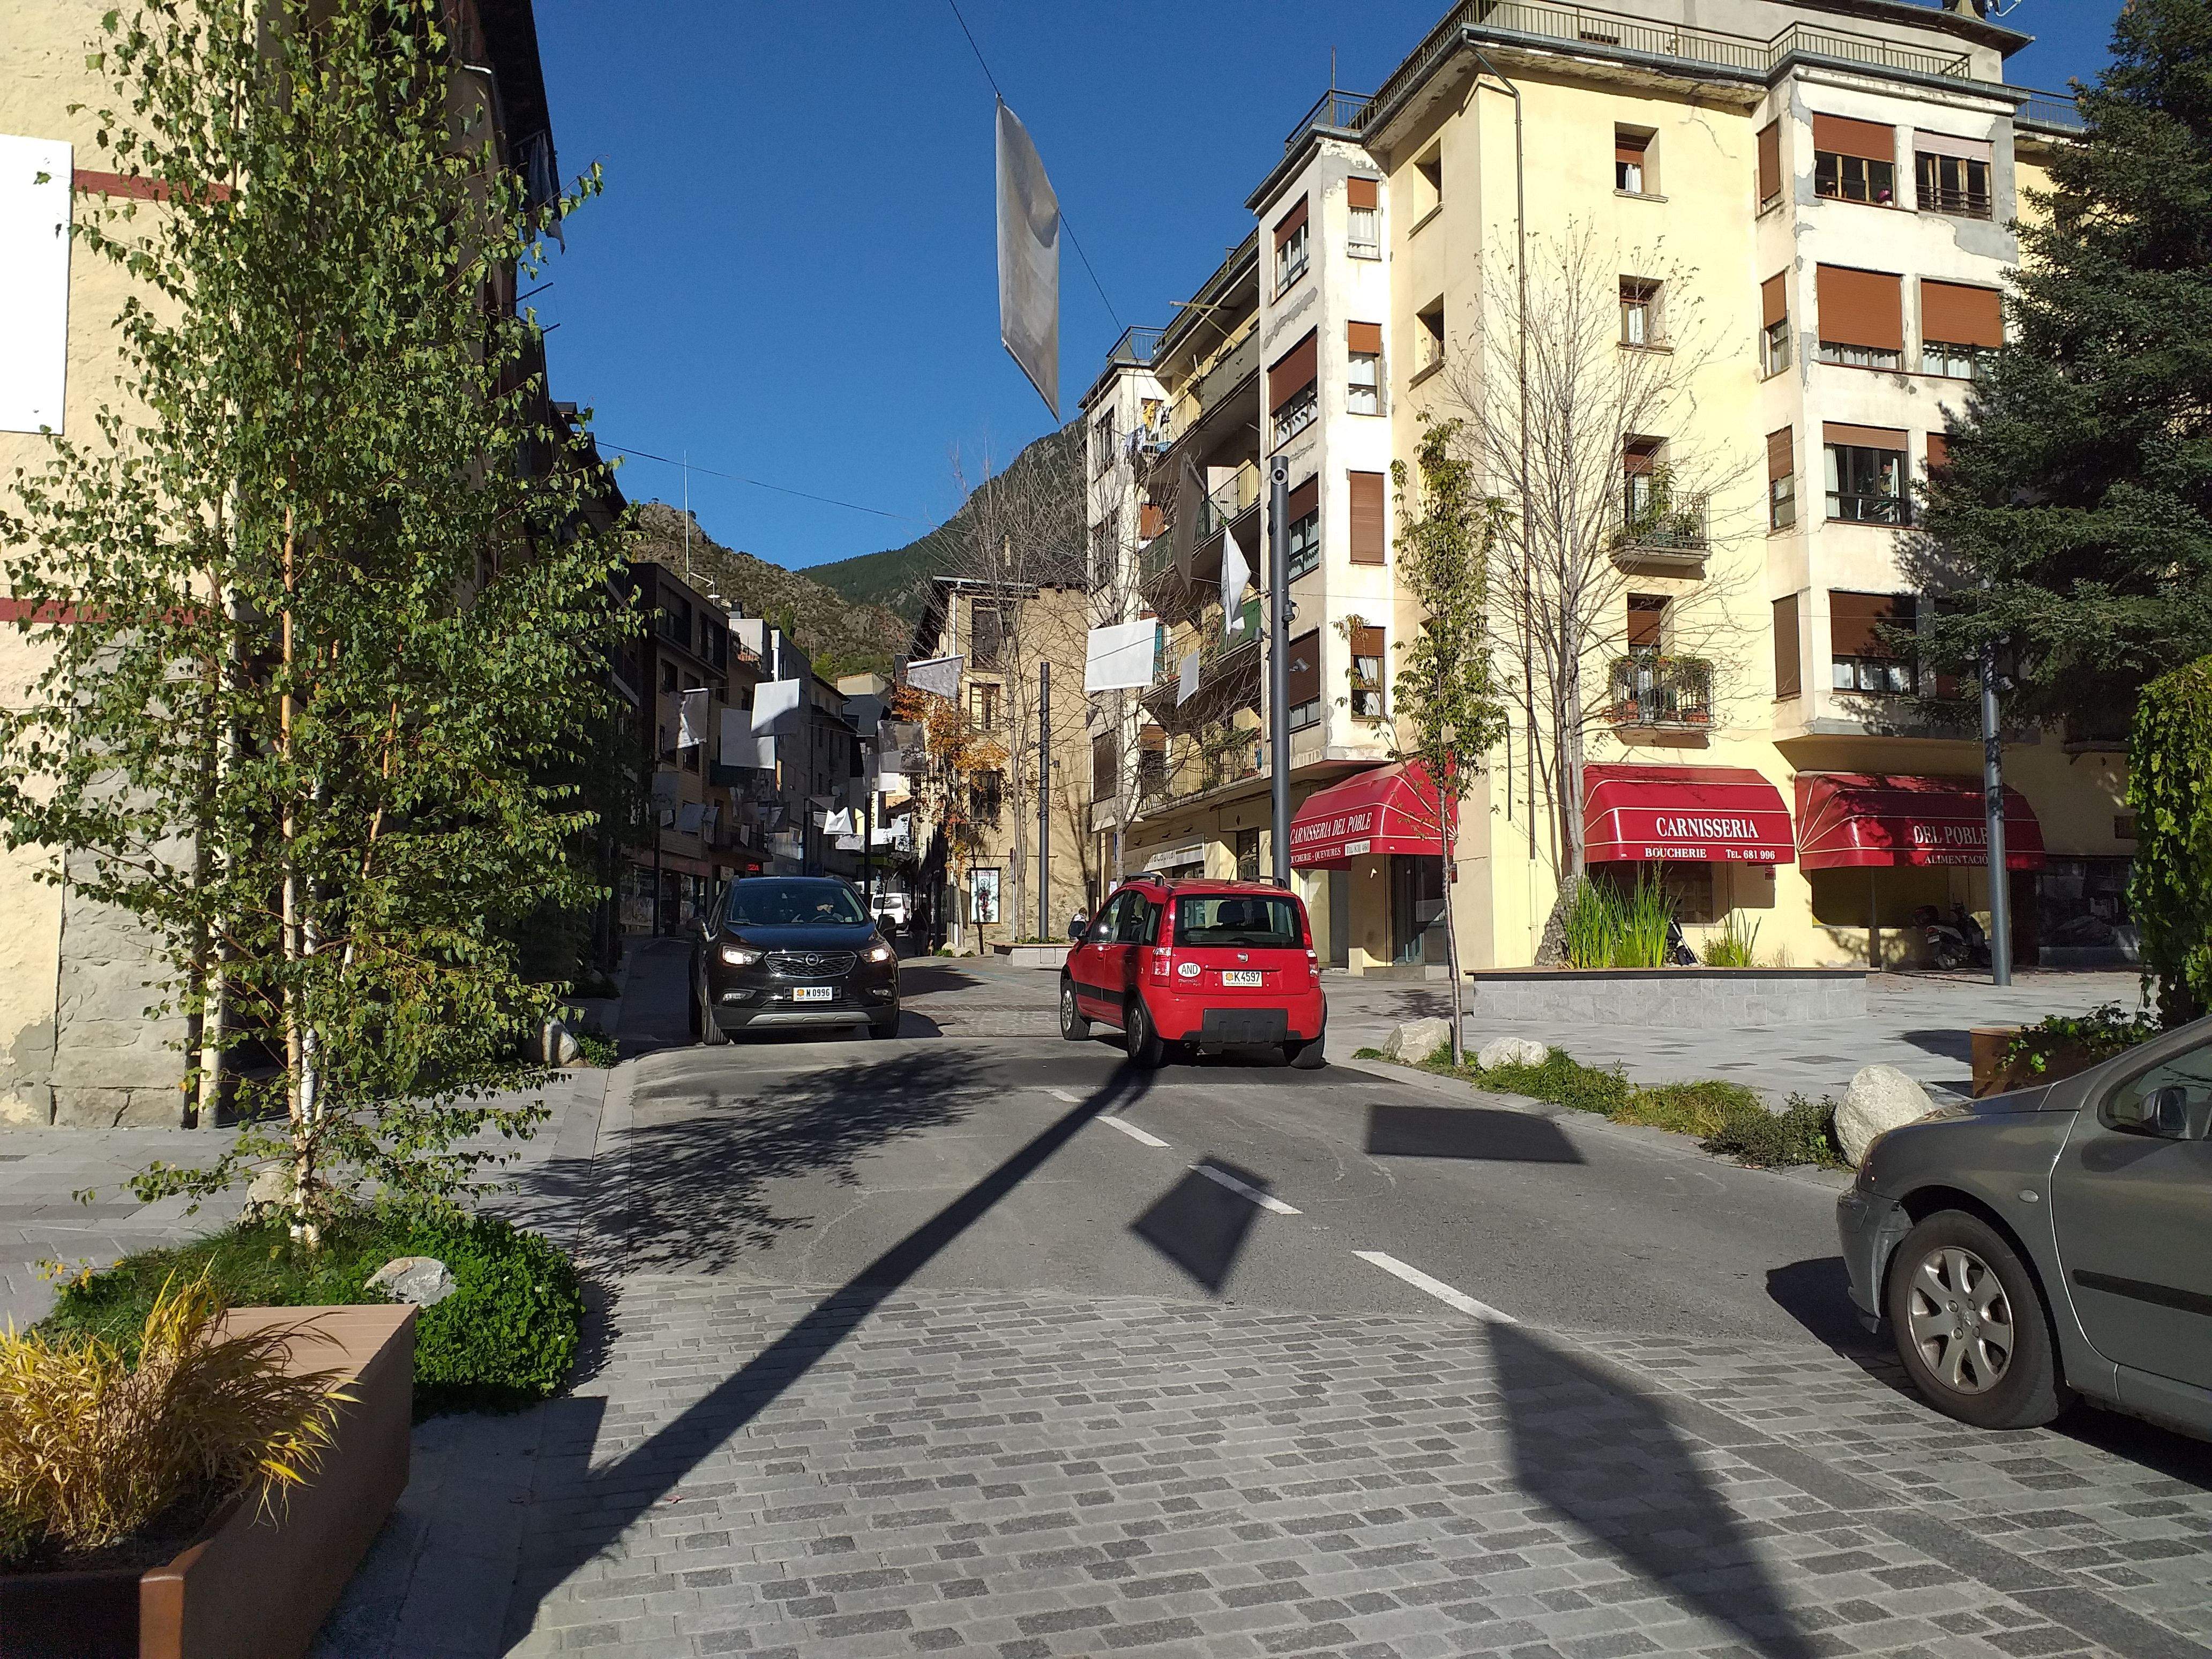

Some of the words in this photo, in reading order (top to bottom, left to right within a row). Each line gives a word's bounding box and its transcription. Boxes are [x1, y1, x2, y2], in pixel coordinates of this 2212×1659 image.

[1290, 821, 1331, 845] CARNISSERIA
[1332, 818, 1346, 836] DEL
[1347, 812, 1372, 833] POBLE
[1656, 817, 1759, 839] CARNISSERIA
[1913, 825, 1942, 844] DEL
[1944, 826, 1987, 845] POBLE
[1314, 847, 1341, 861] QUEVIURES
[1645, 848, 1707, 858] BOUCHERIE
[1743, 850, 1758, 859] 681
[1760, 850, 1775, 860] 996
[1925, 854, 1988, 864] ALIMENTACIÓ
[1181, 965, 1198, 975] AND
[812, 988, 830, 997] 0996
